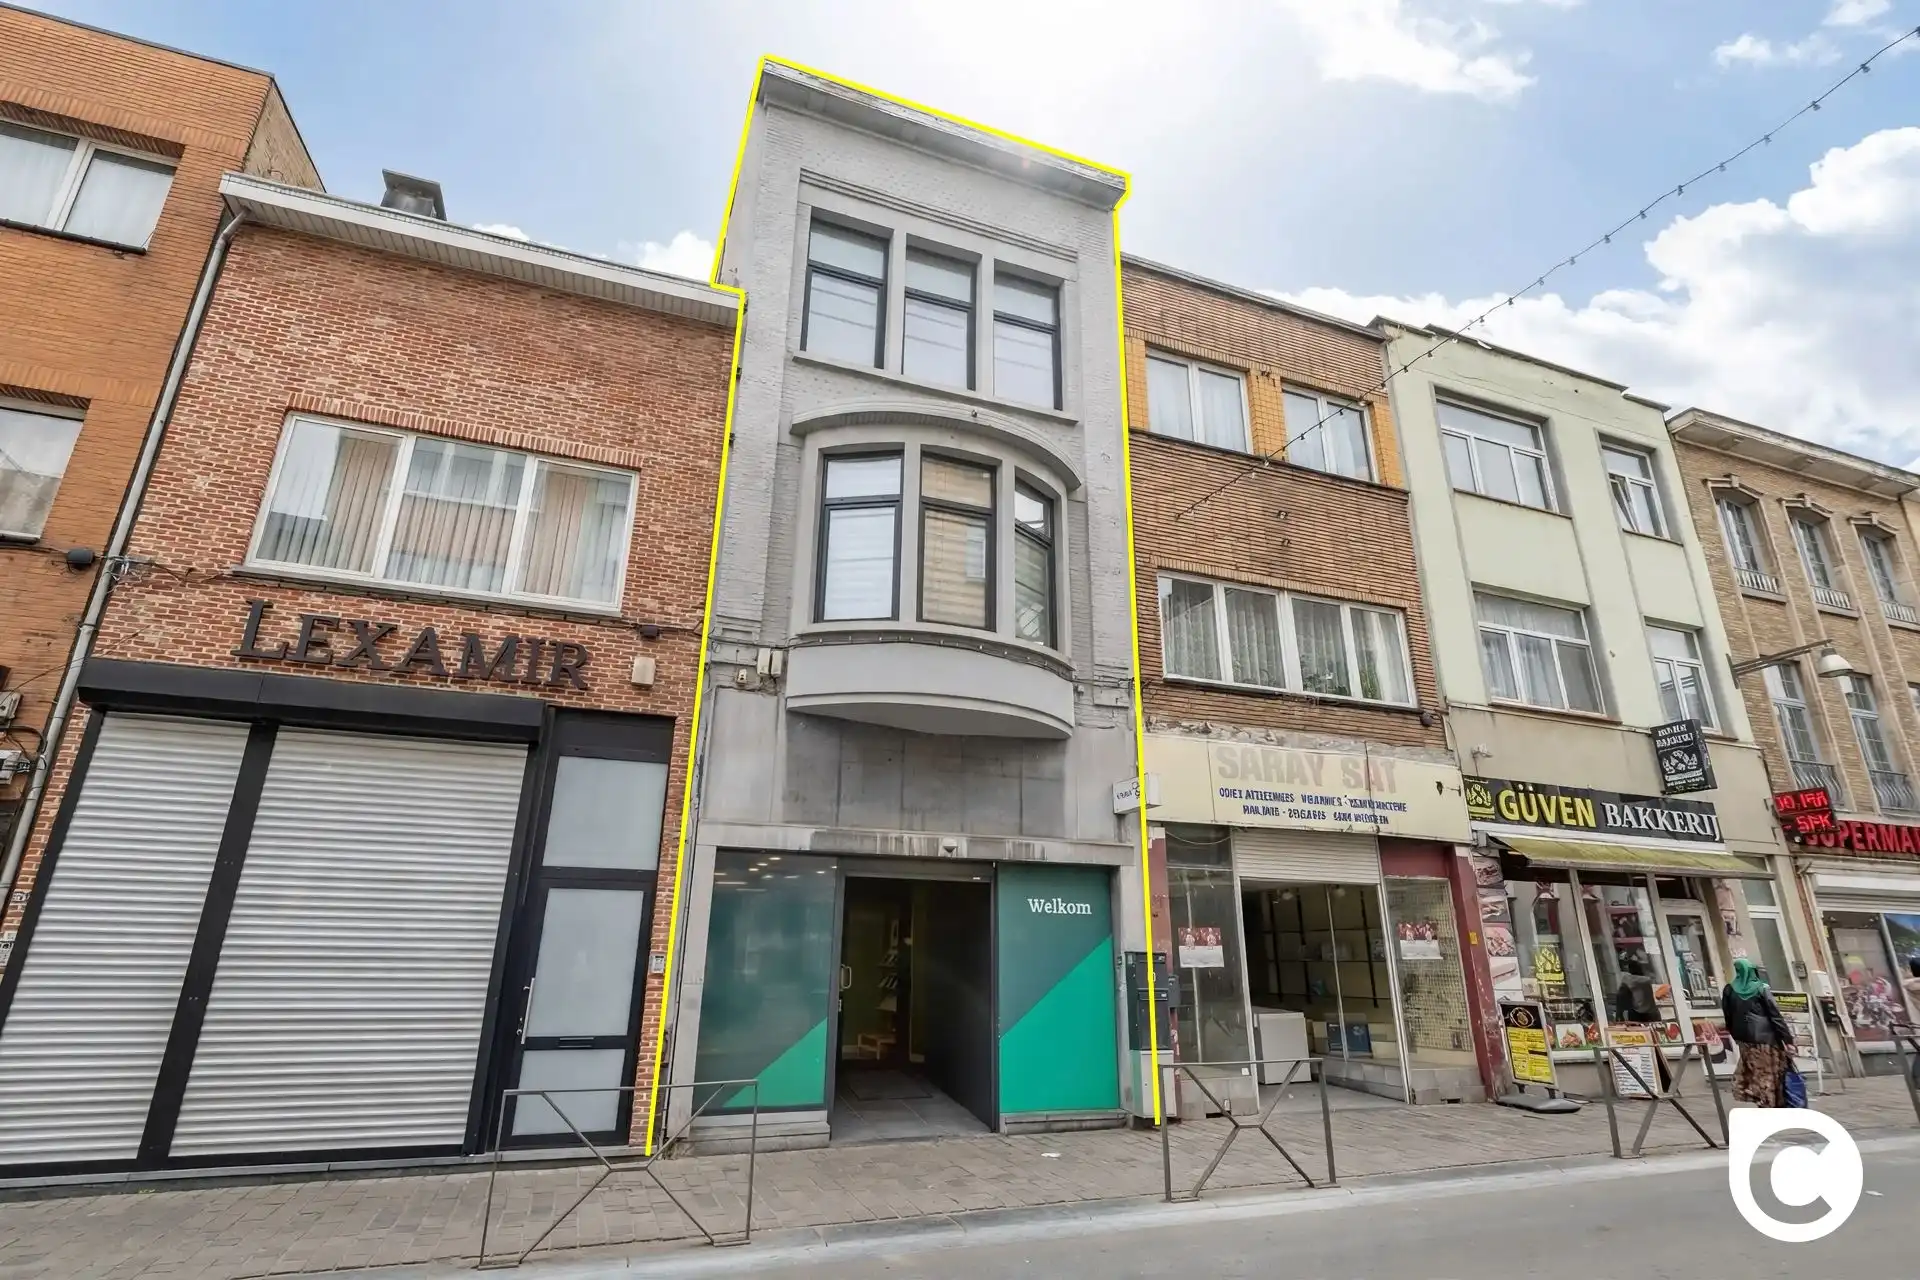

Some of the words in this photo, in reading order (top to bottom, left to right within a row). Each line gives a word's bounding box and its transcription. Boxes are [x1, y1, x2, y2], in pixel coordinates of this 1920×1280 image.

[229, 599, 590, 691] LEXAMIR
[1217, 746, 1325, 787] SARAY
[1499, 783, 1597, 828] GÜVEN
[1600, 802, 1720, 842] BAKKERIJ
[1027, 898, 1092, 915] Welkom
